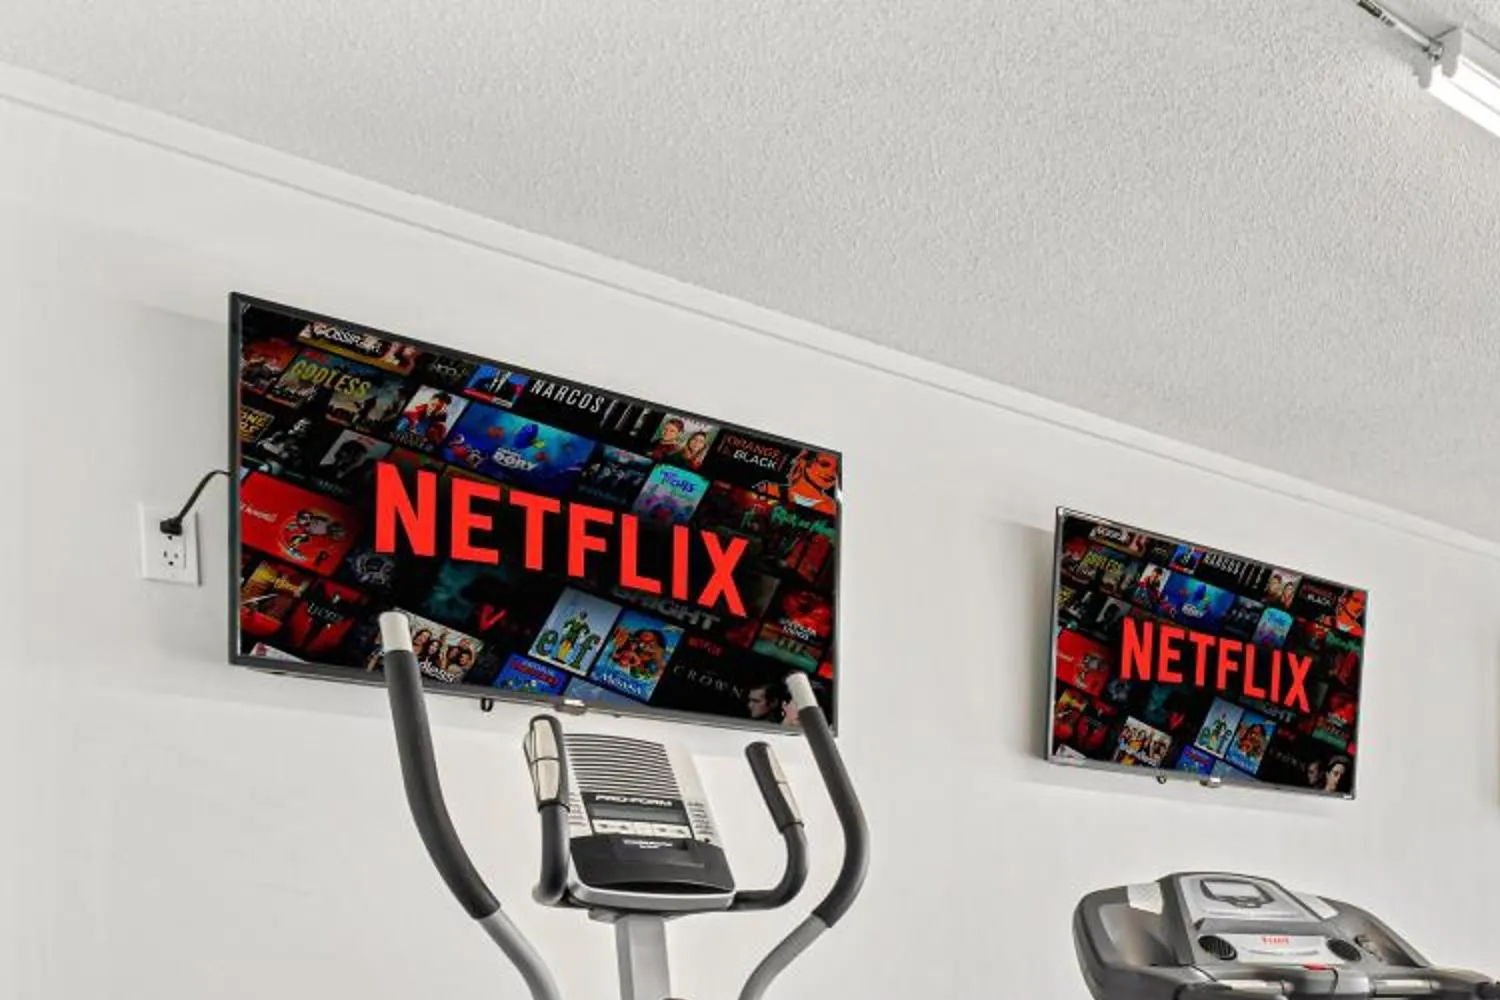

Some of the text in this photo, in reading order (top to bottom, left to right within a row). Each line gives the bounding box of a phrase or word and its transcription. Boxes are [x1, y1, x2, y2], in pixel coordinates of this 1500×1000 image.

[290, 360, 371, 396] GODLESS
[530, 379, 605, 413] NARCOS
[733, 449, 777, 469] BLACK
[375, 461, 749, 618] NETFLIX
[1119, 616, 1313, 714] NETFLIX
